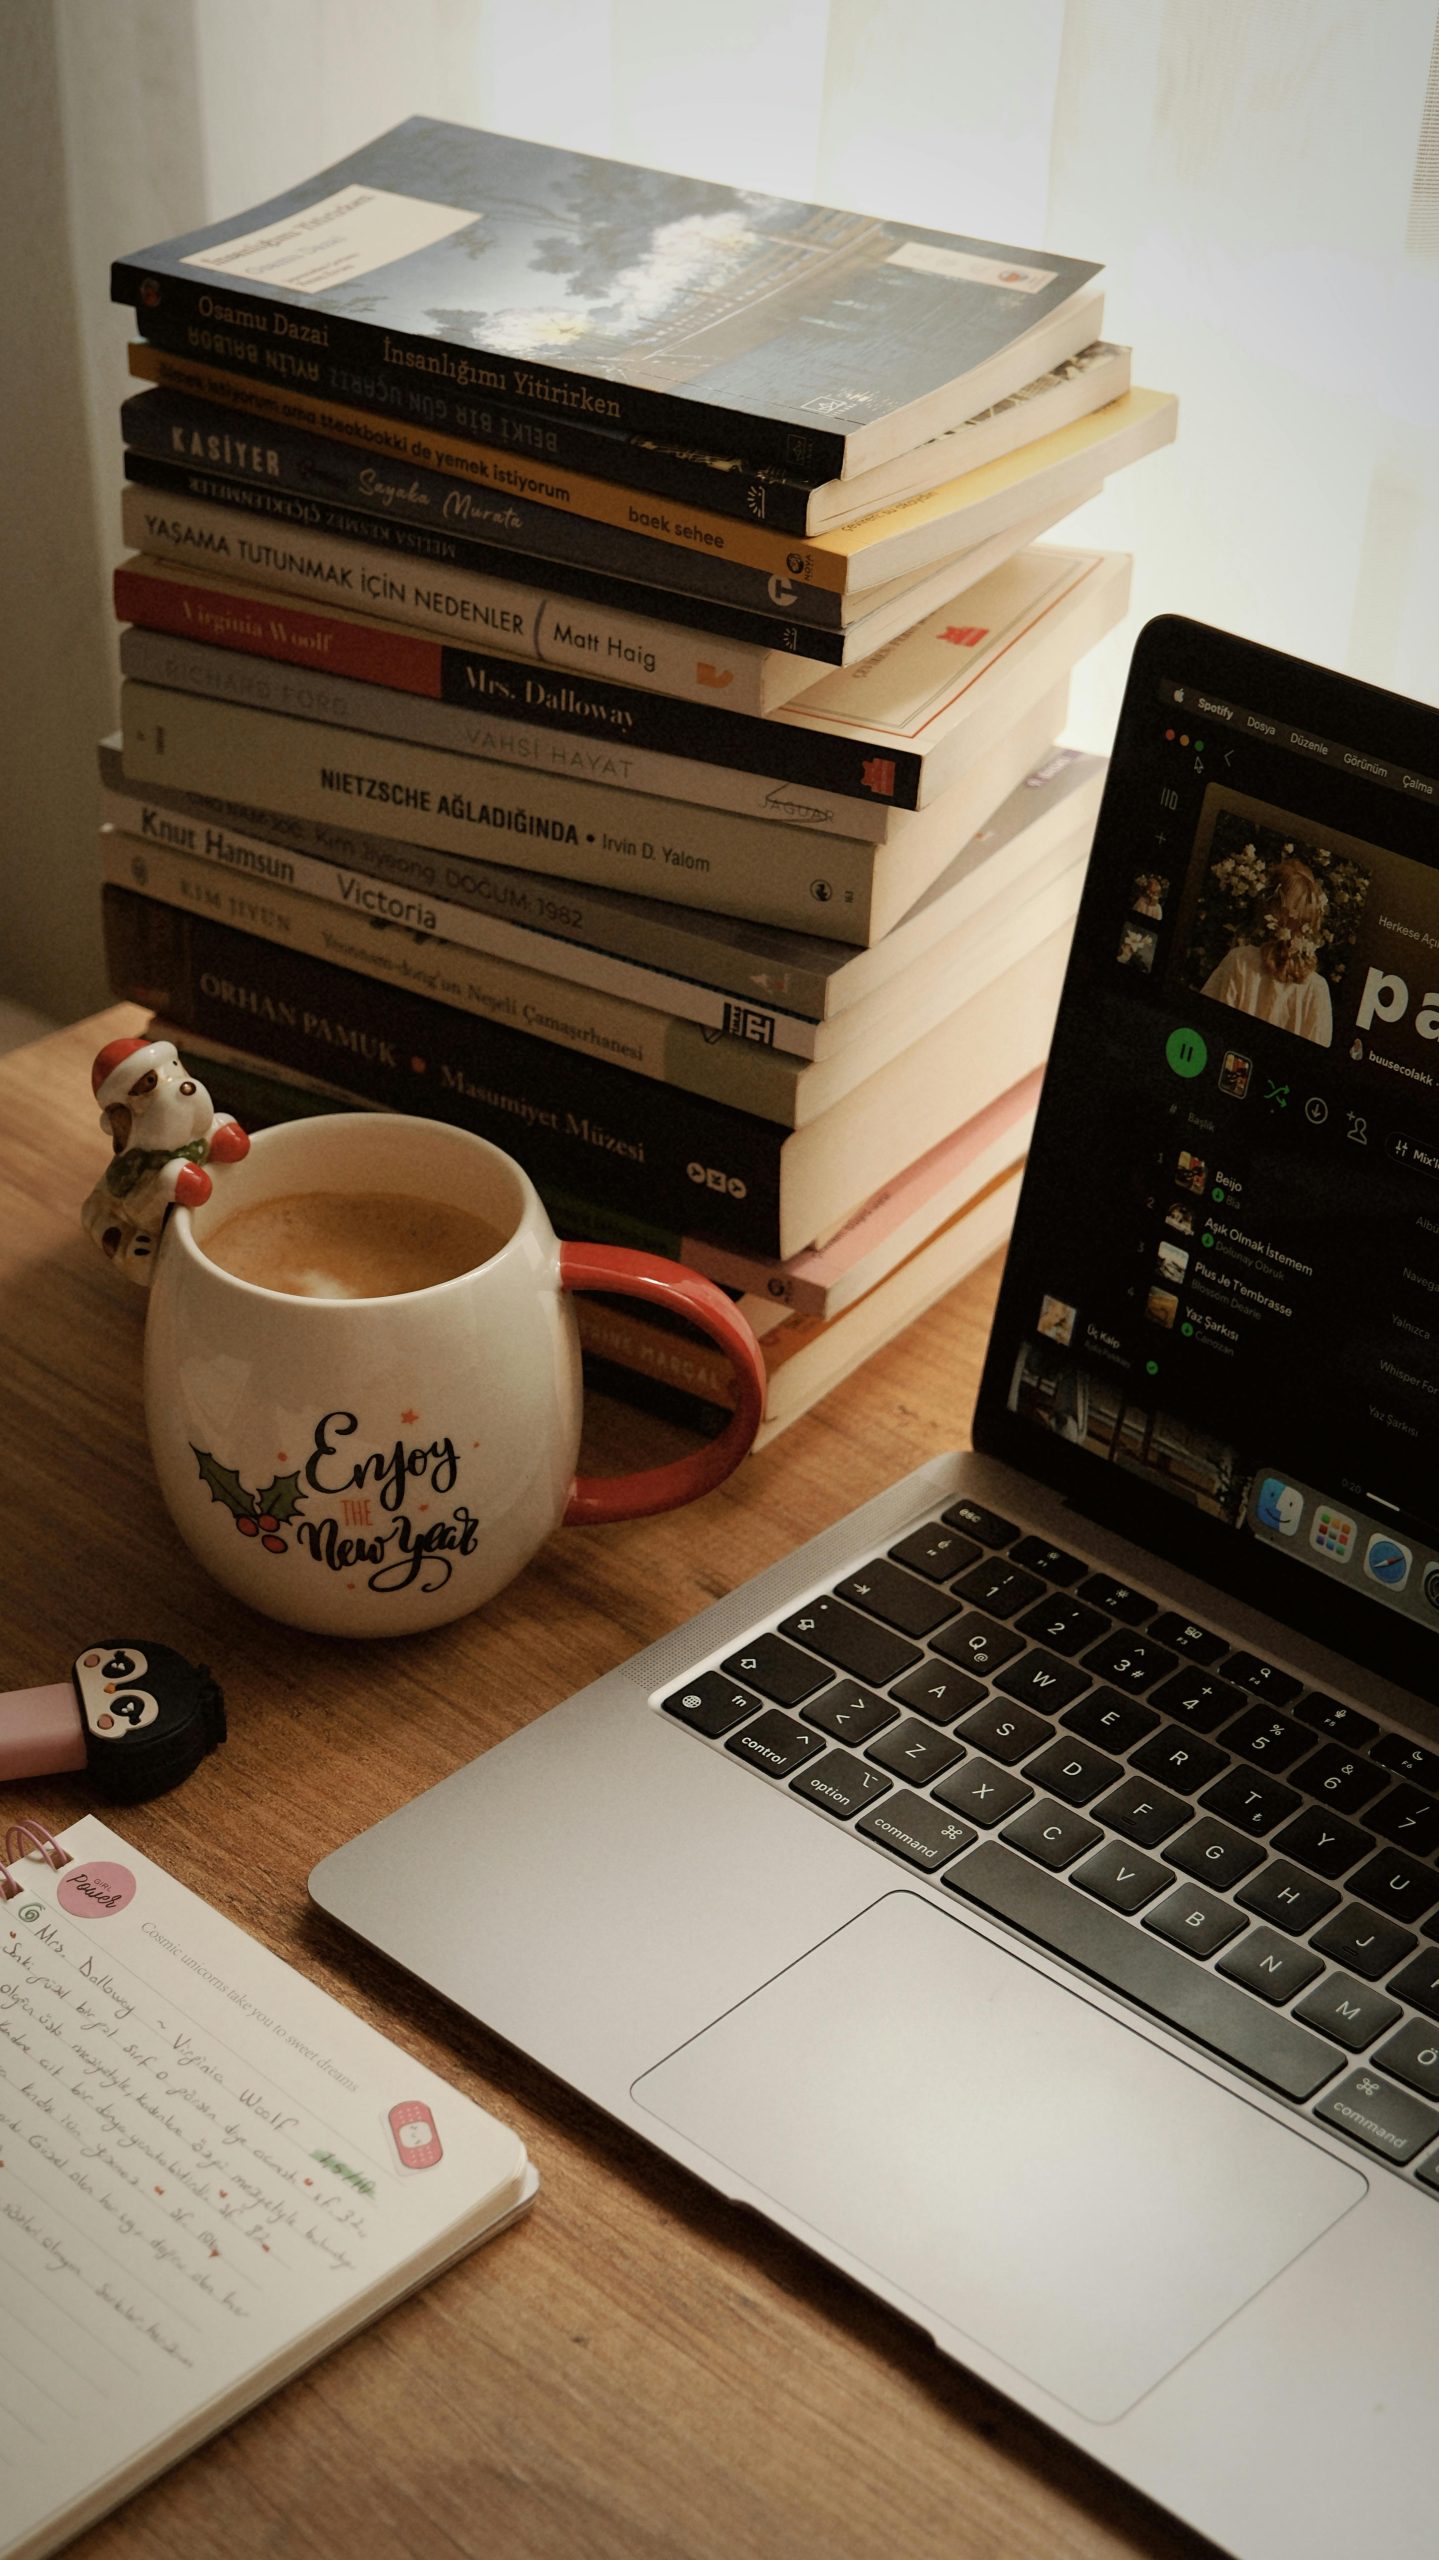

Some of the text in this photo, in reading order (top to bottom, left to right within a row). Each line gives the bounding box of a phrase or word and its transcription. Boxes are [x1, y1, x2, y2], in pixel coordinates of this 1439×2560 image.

[186, 326, 259, 364] BALBOA
[198, 295, 622, 419] Osamu Dazai İnsanlığımı Yitirirken
[408, 386, 448, 421] GÜN
[456, 406, 492, 435] BİR
[501, 417, 559, 452] BELKİ
[171, 425, 525, 532] KASİYER Sayaka Murata
[281, 402, 317, 425] ama
[410, 440, 433, 459] de
[435, 452, 489, 481] yemek
[493, 463, 572, 504] istiyorum
[628, 504, 670, 533] baek
[673, 520, 726, 550] sehee
[144, 515, 657, 674] YAŞAMA TUTUNMAK İÇİN NEDENLER Matt Haig
[183, 600, 635, 735] Virginia Woolf Mrs. Dalloway
[283, 685, 351, 718] FORD
[550, 746, 634, 779] HAYAT
[1196, 697, 1434, 796] Spotify Dosya Düzenle Görünüm Çalma
[320, 767, 712, 874] NIETZSCHE AĞLADIĞINDA Irvin D. Yalom
[141, 806, 438, 931] Knut Hamsun Victoria
[537, 895, 585, 930] 1982
[1377, 914, 1421, 942] Herkese
[199, 971, 646, 1166] ORHAN PAMUK Masumiyet Müzesi
[1214, 1169, 1244, 1194] Beijo
[1203, 1216, 1315, 1278] Aşık Olmak İstemem
[1194, 1260, 1219, 1282] Plus
[1217, 1272, 1231, 1289] Je
[1390, 1312, 1432, 1341] Yalnızca
[1182, 1305, 1204, 1325] Yaz
[1203, 1314, 1240, 1343] Şarkısı
[1378, 1358, 1420, 1391] Whisper
[305, 1410, 461, 1512] Enjoy
[340, 1498, 374, 1527] THE
[958, 1508, 982, 1524] esc
[296, 1517, 392, 1573] New
[985, 1586, 1000, 1598] 1
[1047, 1621, 1066, 1636] 2
[968, 1635, 988, 1651] Q
[1113, 1658, 1132, 1672] 3
[1031, 1670, 1057, 1688] W
[730, 1694, 748, 1708] fn
[927, 1684, 948, 1699] A
[1181, 1698, 1200, 1710] 4
[1100, 1711, 1121, 1726] E
[995, 1722, 1015, 1737] S
[740, 1734, 788, 1767] control
[904, 1742, 927, 1759] Z
[1251, 1736, 1271, 1750] 5
[1168, 1750, 1189, 1766] R
[1062, 1761, 1083, 1777] D
[809, 1777, 852, 1808] option
[971, 1783, 995, 1800] X
[1323, 1777, 1342, 1790] 6
[1244, 1790, 1263, 1805] T
[1132, 1802, 1154, 1815] F
[1042, 1825, 1063, 1841] C
[1397, 1816, 1417, 1829] 7
[873, 1816, 939, 1860] command
[1316, 1832, 1336, 1847] Y
[1205, 1845, 1225, 1860] G
[92, 1876, 114, 1892] GIRL
[1115, 1866, 1136, 1883] V
[1389, 1874, 1411, 1891] U
[66, 1872, 124, 1910] Power
[1276, 1886, 1301, 1905] H
[1184, 1910, 1206, 1928] B
[34, 1923, 67, 1958] Mrs.
[1355, 1935, 1376, 1948] J
[1258, 1954, 1284, 1974] N
[140, 1921, 360, 2093] Cosmic unicorns take you to sweet dreams
[1335, 1999, 1362, 2021] M
[1416, 2047, 1439, 2067] Ö
[1332, 2100, 1409, 2150] command
